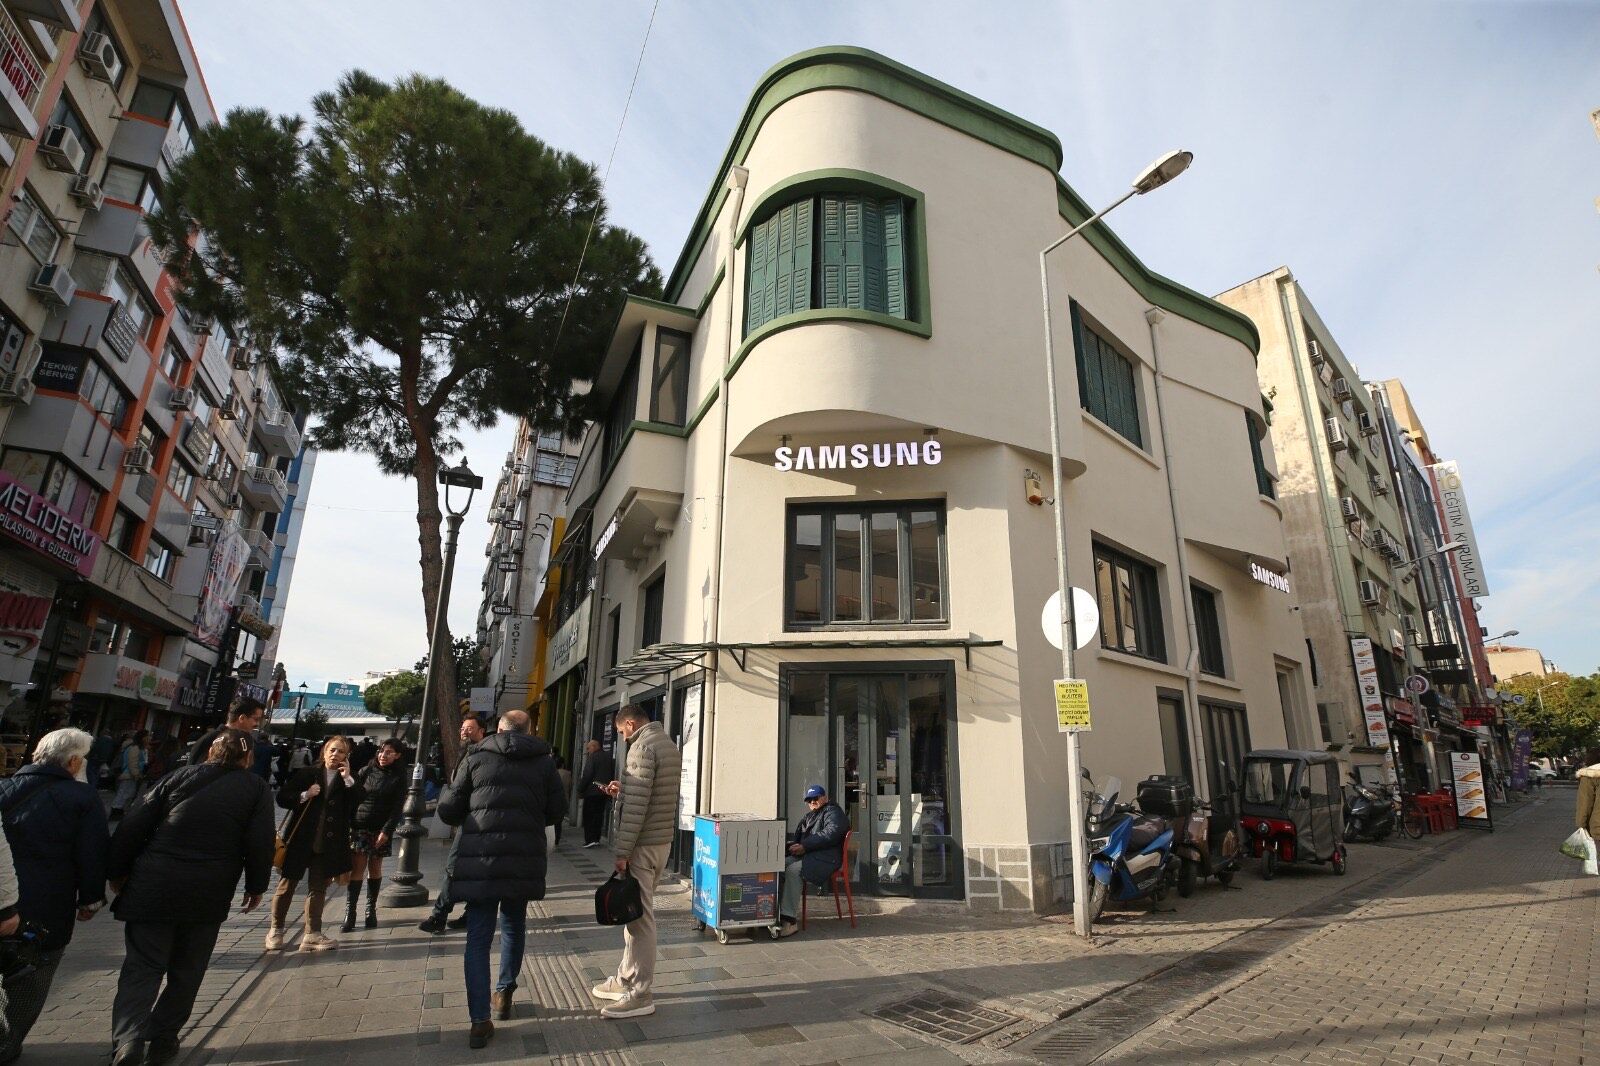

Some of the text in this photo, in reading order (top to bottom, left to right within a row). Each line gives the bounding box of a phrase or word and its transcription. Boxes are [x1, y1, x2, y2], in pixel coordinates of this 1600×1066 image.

[774, 440, 942, 472] SAMSUNG
[40, 536, 47, 549] &
[1251, 562, 1290, 594] SAMSUNG
